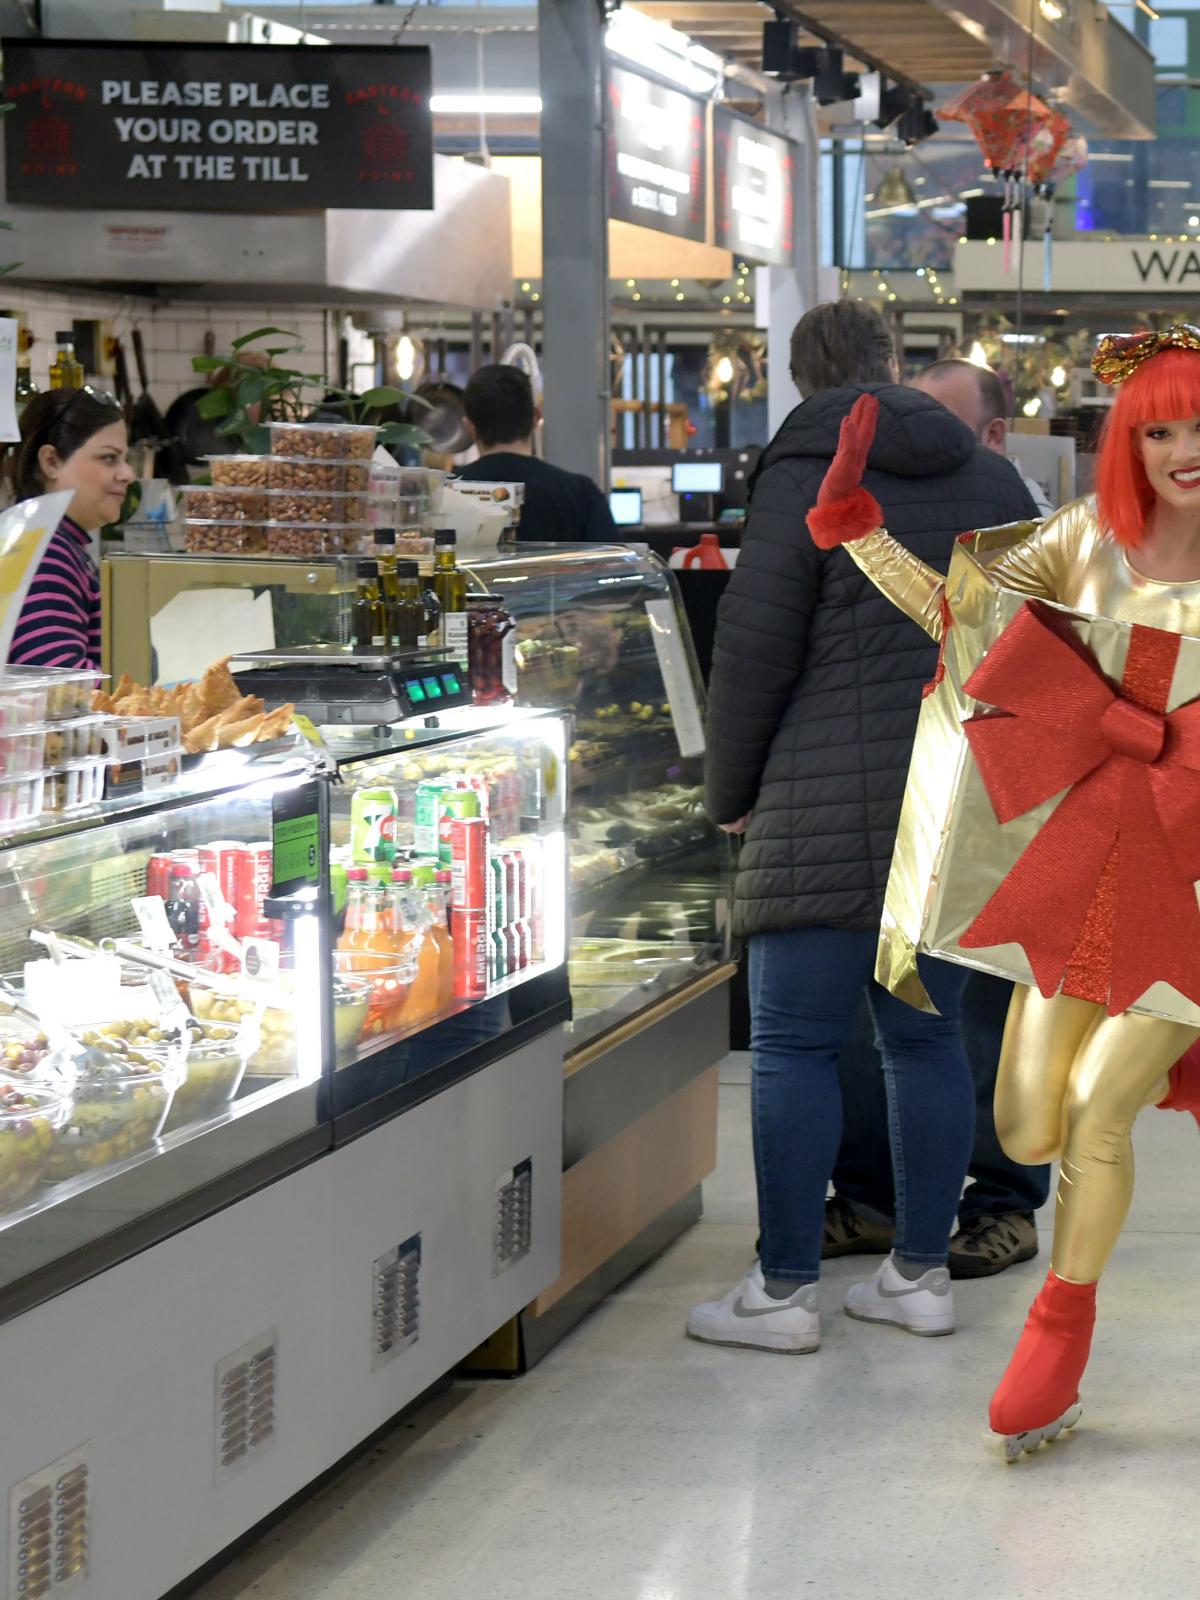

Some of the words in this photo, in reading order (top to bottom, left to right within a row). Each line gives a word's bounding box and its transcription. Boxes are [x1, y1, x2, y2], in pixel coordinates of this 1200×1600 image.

[102, 80, 222, 107] PLEASE
[229, 83, 330, 109] PLACE
[114, 117, 201, 144] YOUR
[208, 120, 319, 146] ORDER
[127, 155, 171, 180] AT
[174, 155, 236, 181] THE
[243, 156, 308, 182] TILL
